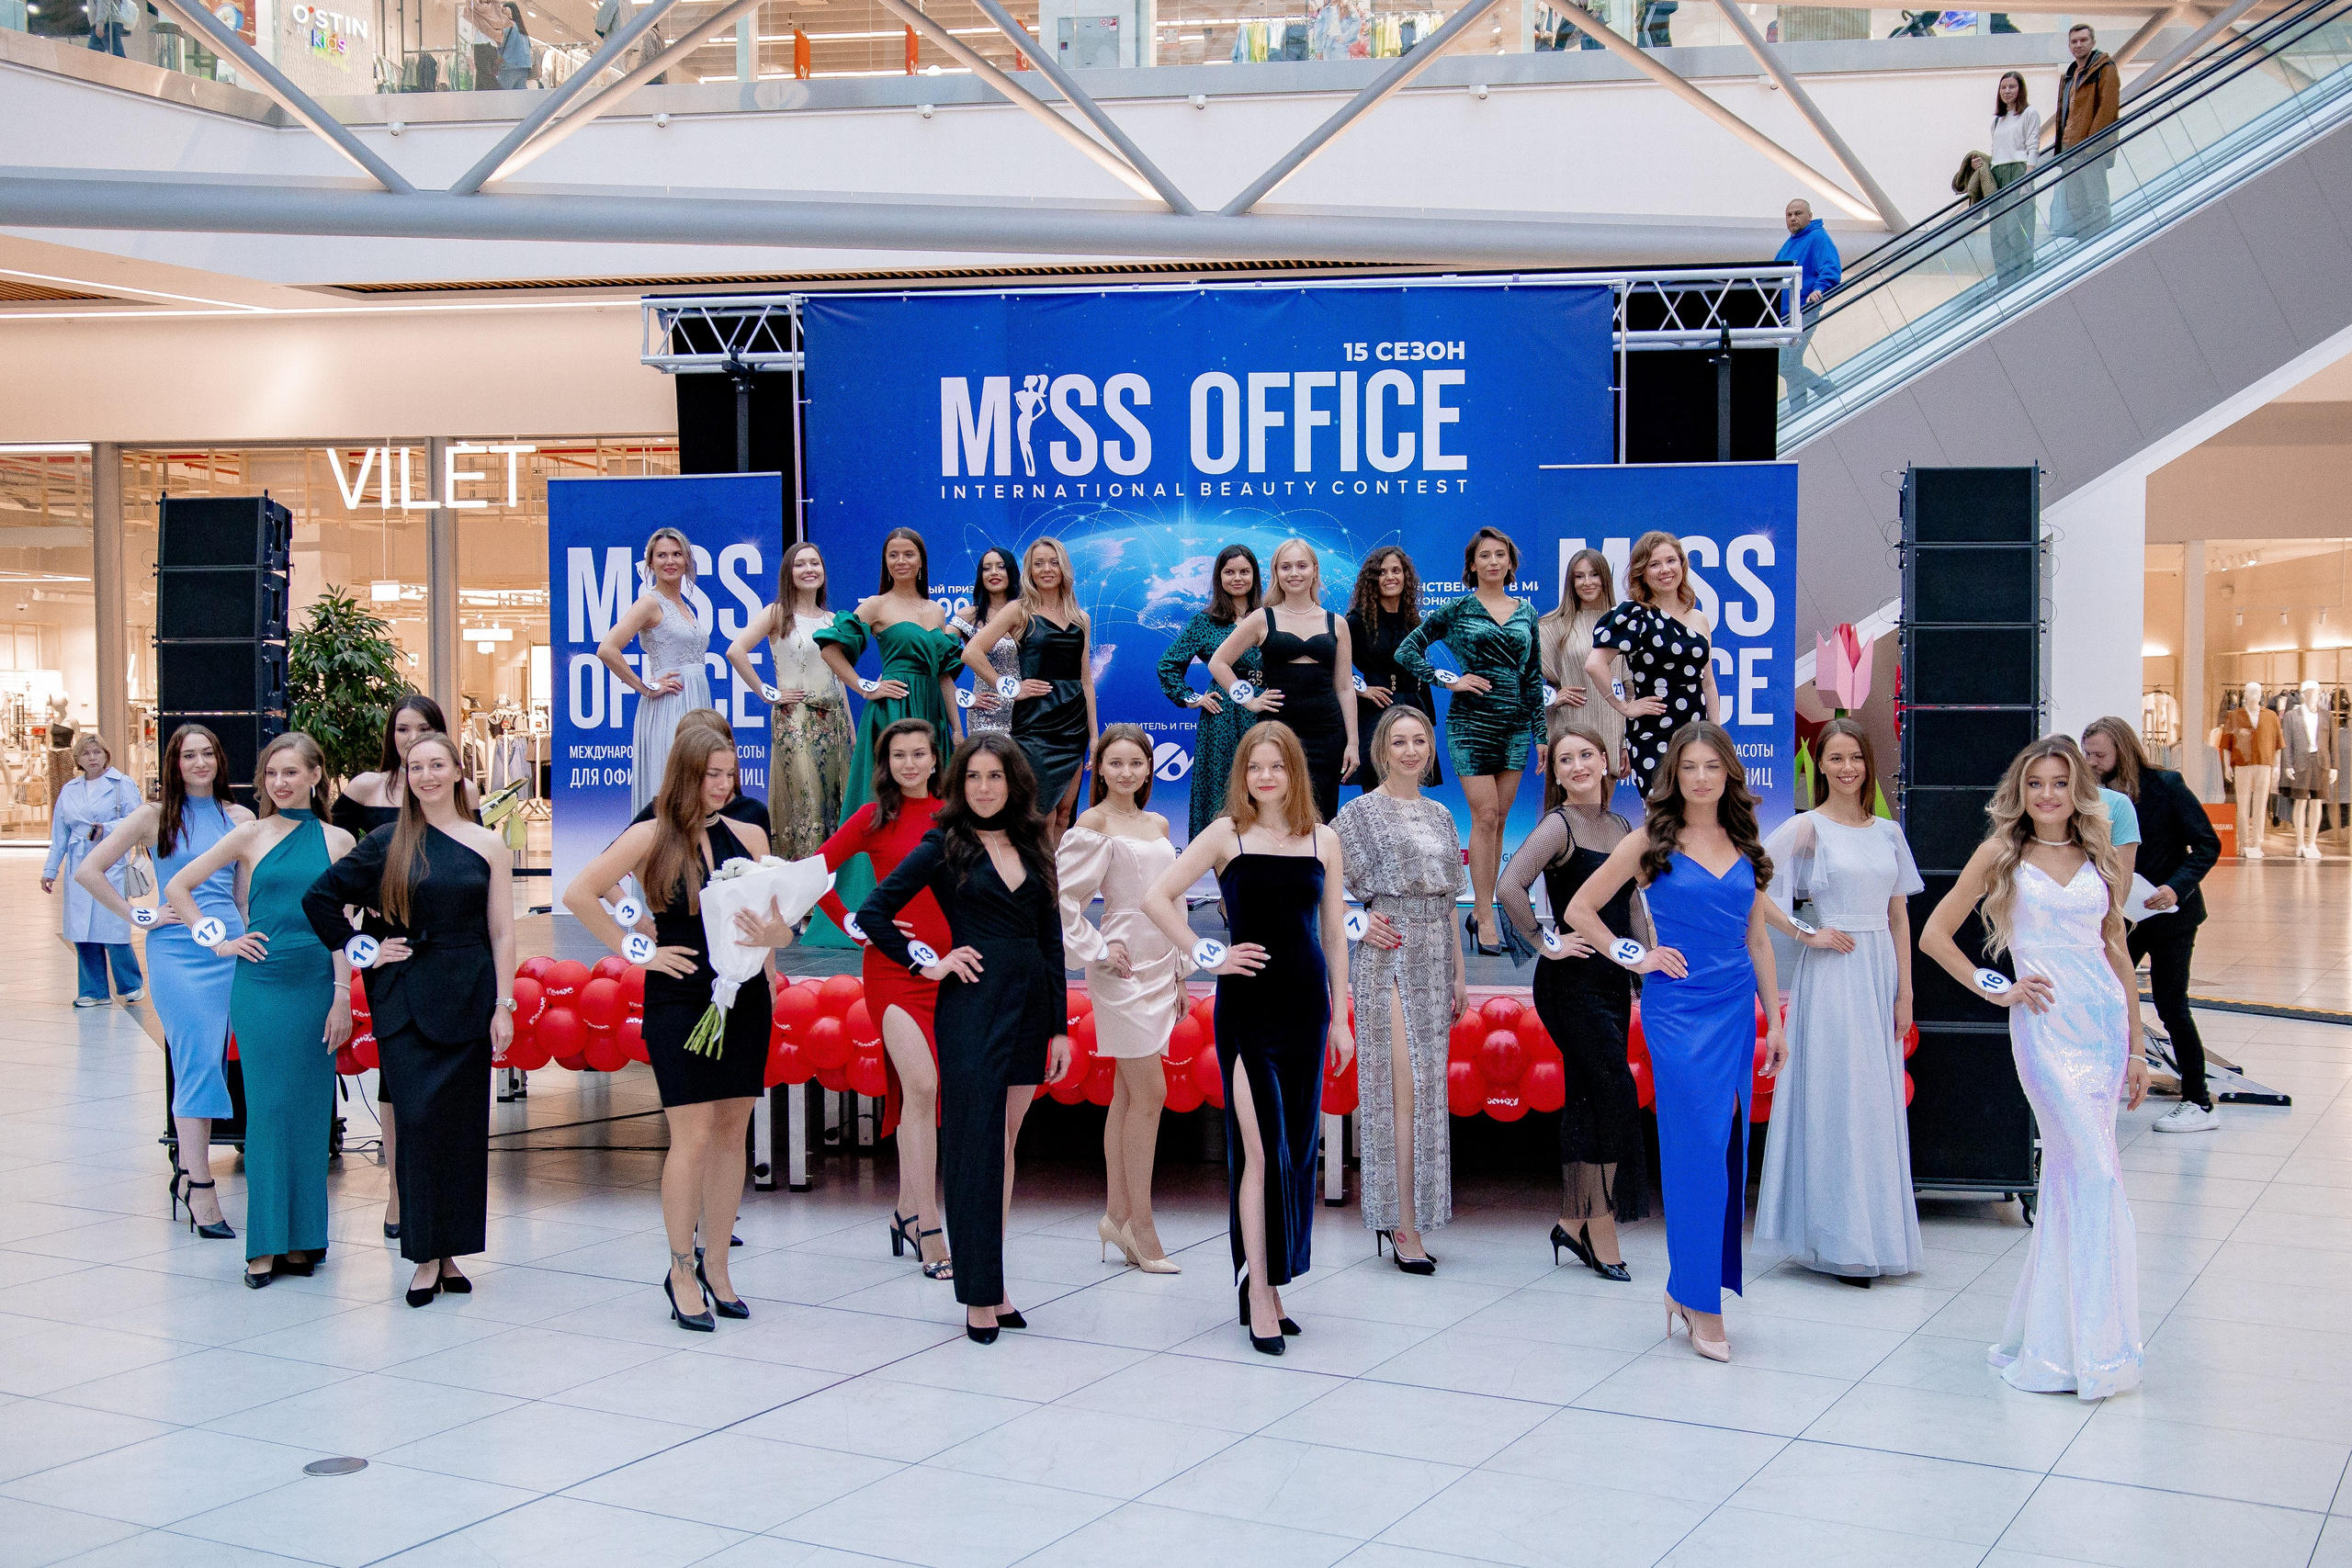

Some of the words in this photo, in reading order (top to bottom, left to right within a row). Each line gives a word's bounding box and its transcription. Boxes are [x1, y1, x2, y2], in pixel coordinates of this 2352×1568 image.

[311, 28, 346, 54] kids
[1343, 343, 1369, 362] 15
[1375, 341, 1465, 361] СЕЗОН
[1190, 368, 1468, 475] OFFICE
[326, 445, 537, 509] VILET
[941, 482, 1185, 500] INTERNATIONAL
[1200, 480, 1317, 497] BEAUTY
[1331, 479, 1468, 495] CONTEST
[567, 543, 763, 643] MSS
[1352, 676, 1363, 690] 34
[1440, 671, 1454, 682] 31
[764, 686, 775, 699] 21
[1001, 677, 1016, 695] 25
[1232, 683, 1251, 701] 33
[1612, 683, 1623, 695] 27
[958, 690, 971, 705] 24
[570, 745, 634, 761] МЕЖДУНАРО
[570, 768, 600, 789] ДЛЯ
[137, 908, 152, 922] 18
[621, 905, 635, 919] 3
[197, 920, 219, 942] 17
[1347, 916, 1362, 932] 7
[629, 937, 649, 958] 12
[1544, 932, 1555, 946] 8
[353, 940, 375, 962] 11
[914, 947, 934, 962] 13
[1199, 942, 1222, 964] 14
[1617, 942, 1640, 960] 15
[1981, 973, 2004, 989] 16
